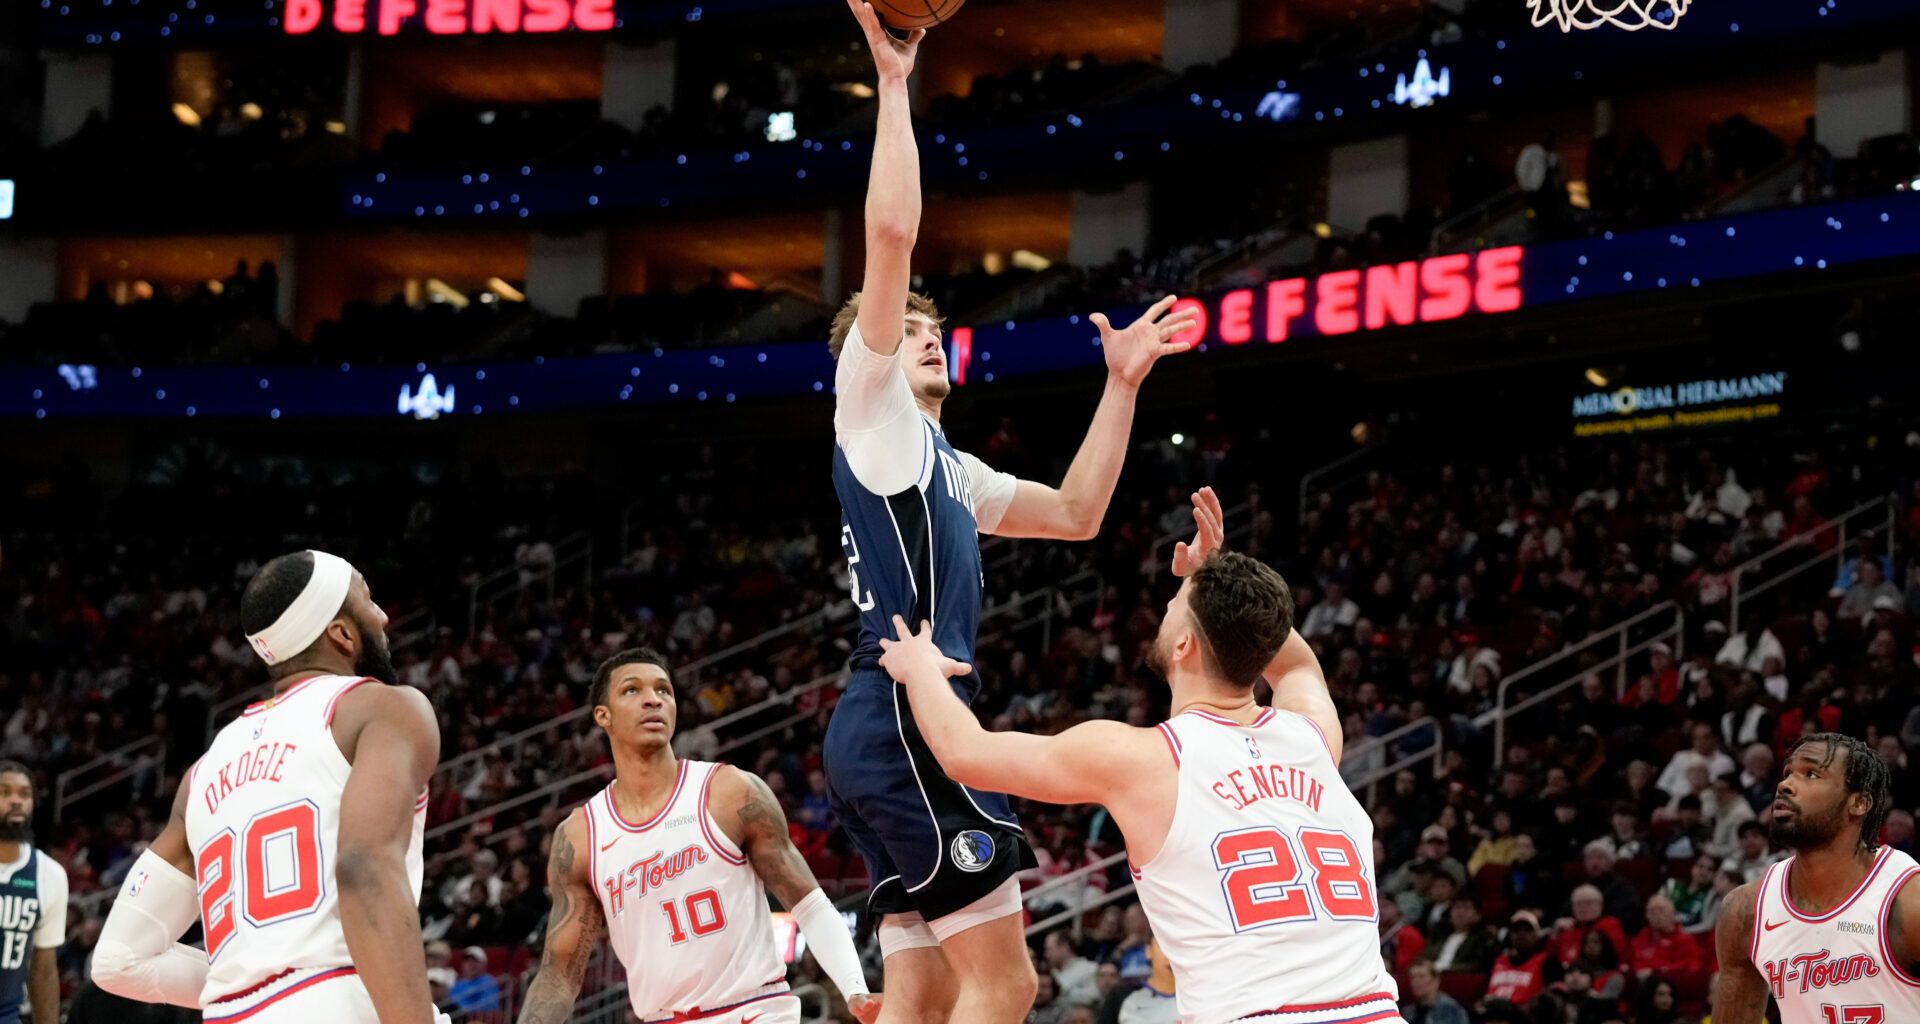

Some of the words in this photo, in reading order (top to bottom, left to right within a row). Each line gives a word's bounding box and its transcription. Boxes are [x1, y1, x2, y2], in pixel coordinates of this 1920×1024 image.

[283, 0, 616, 35] DEFENSE
[1168, 246, 1524, 350] DEFENSE
[1572, 384, 1675, 417] MEMORIAL
[1677, 371, 1785, 406] HERMANN
[204, 742, 296, 815] OKOGIE
[1212, 765, 1324, 813] SENGUN
[194, 797, 326, 967] 20
[605, 844, 709, 918] H-Town
[1211, 825, 1381, 934] 28
[660, 887, 728, 946] 10
[1, 930, 29, 970] 13
[1763, 949, 1880, 999] H-Town
